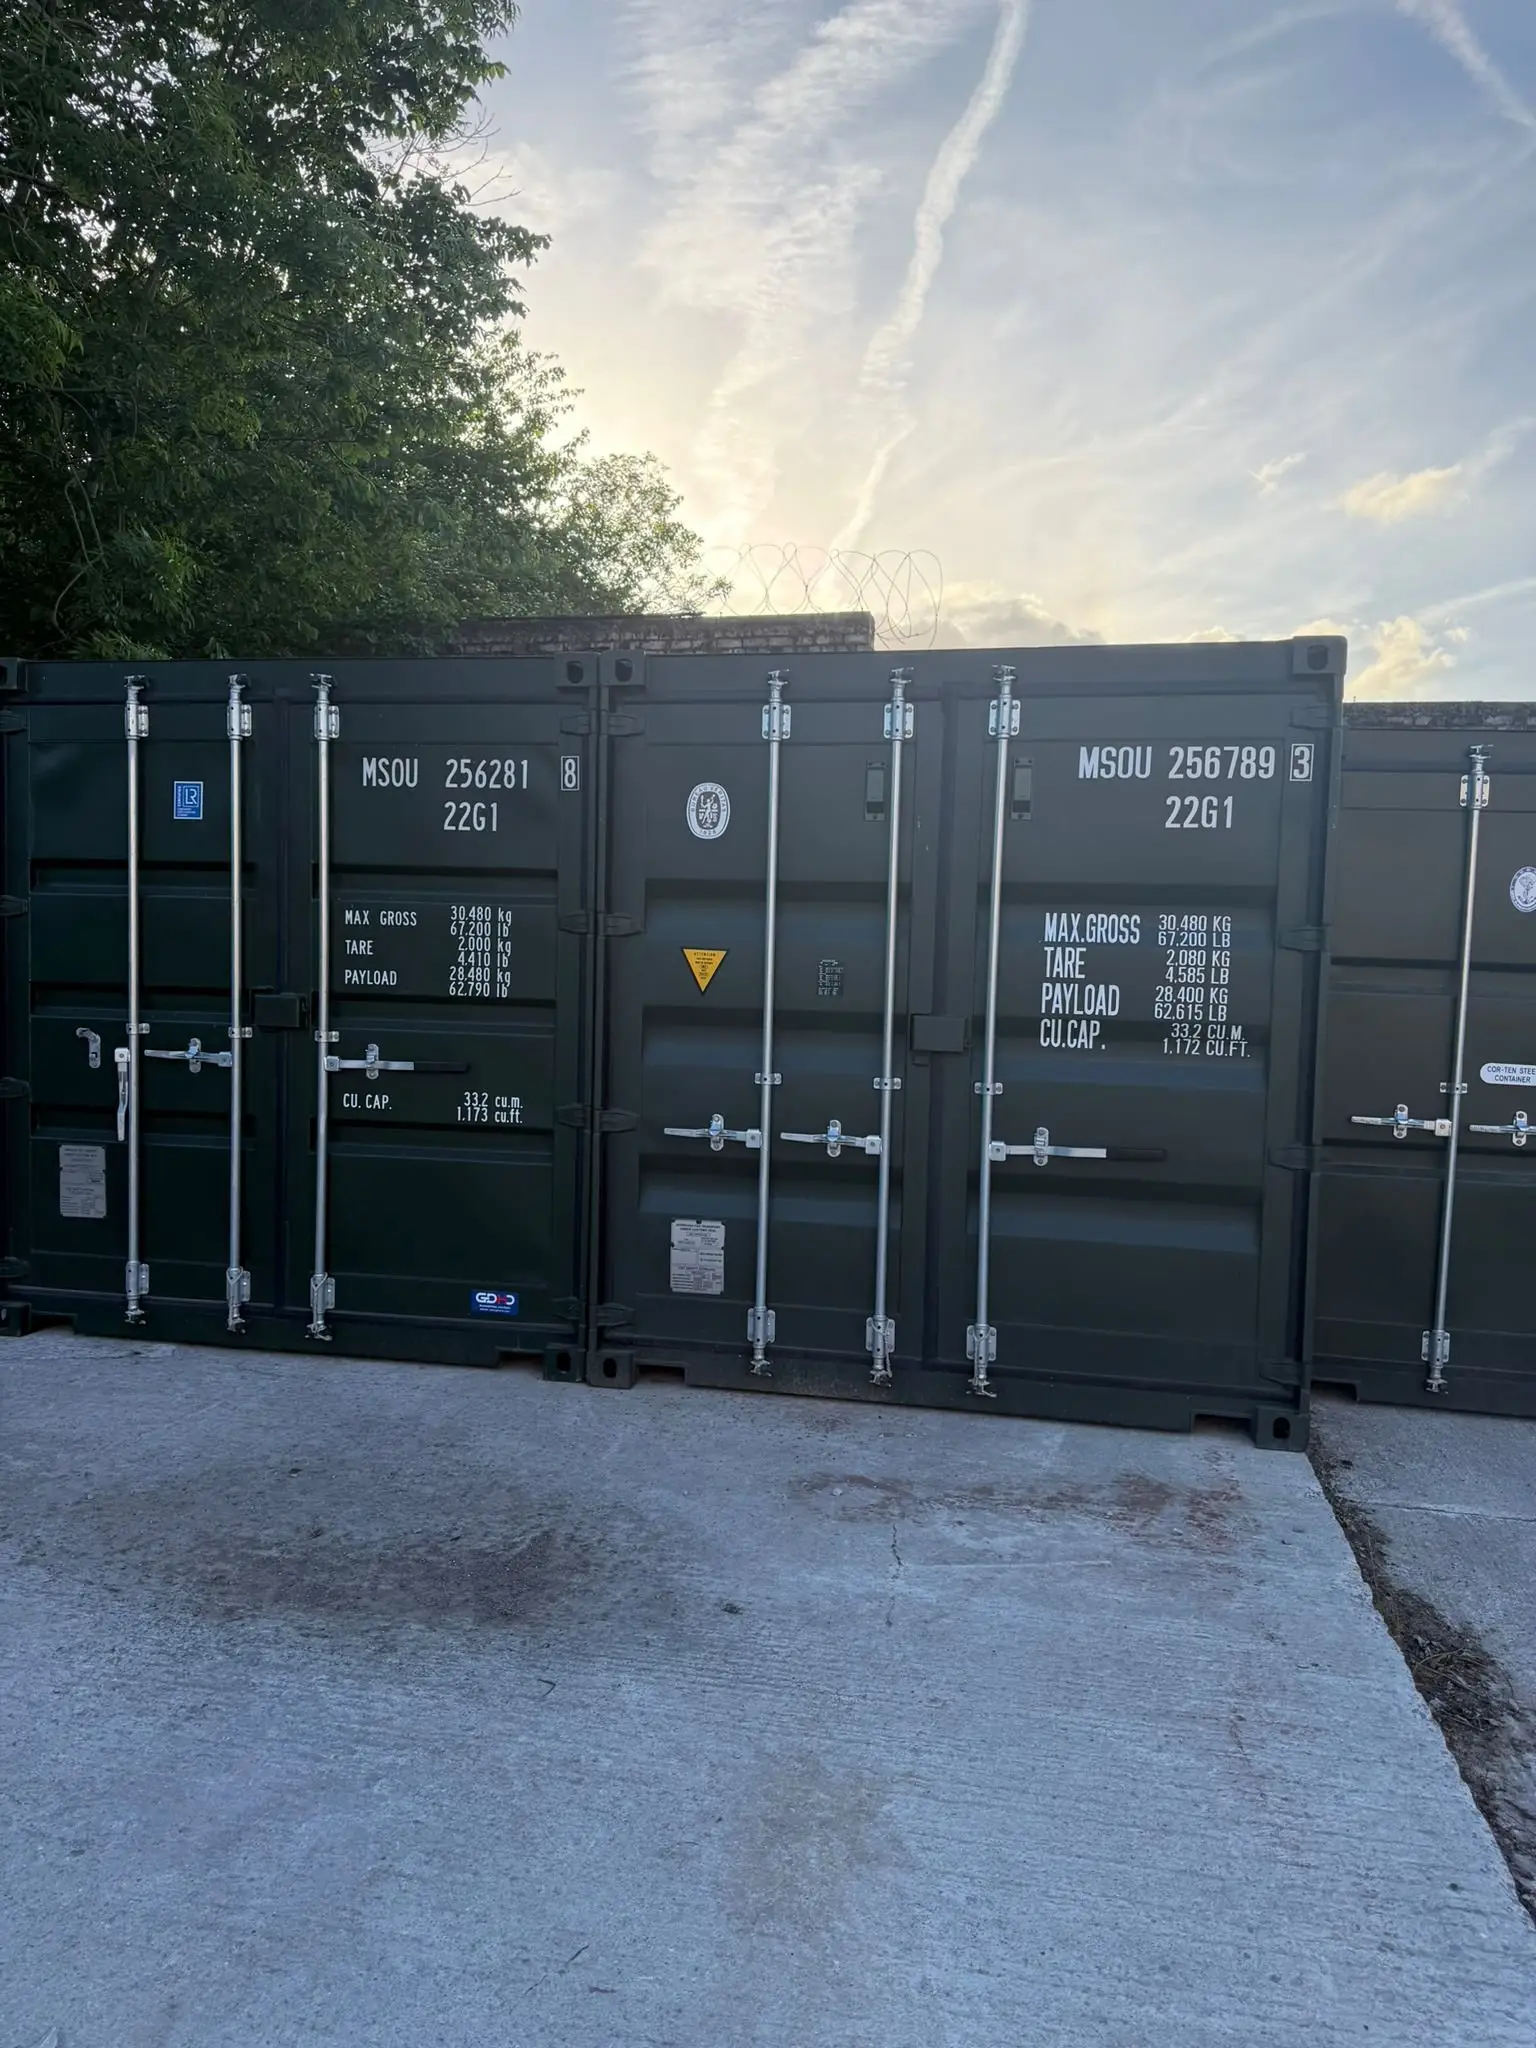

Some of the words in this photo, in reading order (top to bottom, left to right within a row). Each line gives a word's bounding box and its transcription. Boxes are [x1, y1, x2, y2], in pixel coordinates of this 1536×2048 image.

[1077, 746, 1152, 779] MSOU
[1168, 746, 1276, 779] 256789
[1293, 746, 1310, 779] 3
[362, 757, 419, 787] MSOU
[444, 758, 528, 789] 256281
[563, 758, 577, 788] 8
[443, 801, 498, 831] 22G1
[1165, 795, 1234, 829] 22G1
[345, 910, 370, 925] MAX
[379, 911, 418, 926] GROSS
[498, 907, 512, 926] kg
[497, 922, 509, 937] lb
[1044, 912, 1141, 944] MAX.GROSS
[1212, 915, 1232, 933] KG
[345, 939, 374, 955] TARE
[497, 938, 512, 957] kg
[1212, 932, 1231, 948] LB
[497, 952, 509, 968] lb
[1044, 946, 1087, 979] TARE
[1212, 950, 1231, 967] KG
[344, 969, 397, 986] PAYLOAD
[496, 968, 511, 987] kg
[1210, 967, 1230, 985] LB
[496, 983, 508, 998] lb
[1041, 982, 1120, 1016] PAYLOAD
[1209, 987, 1229, 1005] KG
[1208, 1004, 1227, 1022] LB
[1171, 1022, 1202, 1039] 33.2
[1207, 1024, 1246, 1041] CU.M.
[1206, 1040, 1251, 1058] CU.FT.
[1487, 1066, 1516, 1074] COR-TEN
[1520, 1067, 1536, 1075] STEE
[1494, 1075, 1531, 1083] CONTAINER
[343, 1093, 361, 1109] CU.
[365, 1094, 392, 1110] CAP.
[464, 1091, 489, 1107] 33.2
[495, 1096, 523, 1109] cu.m.
[494, 1108, 523, 1124] cu.ft.
